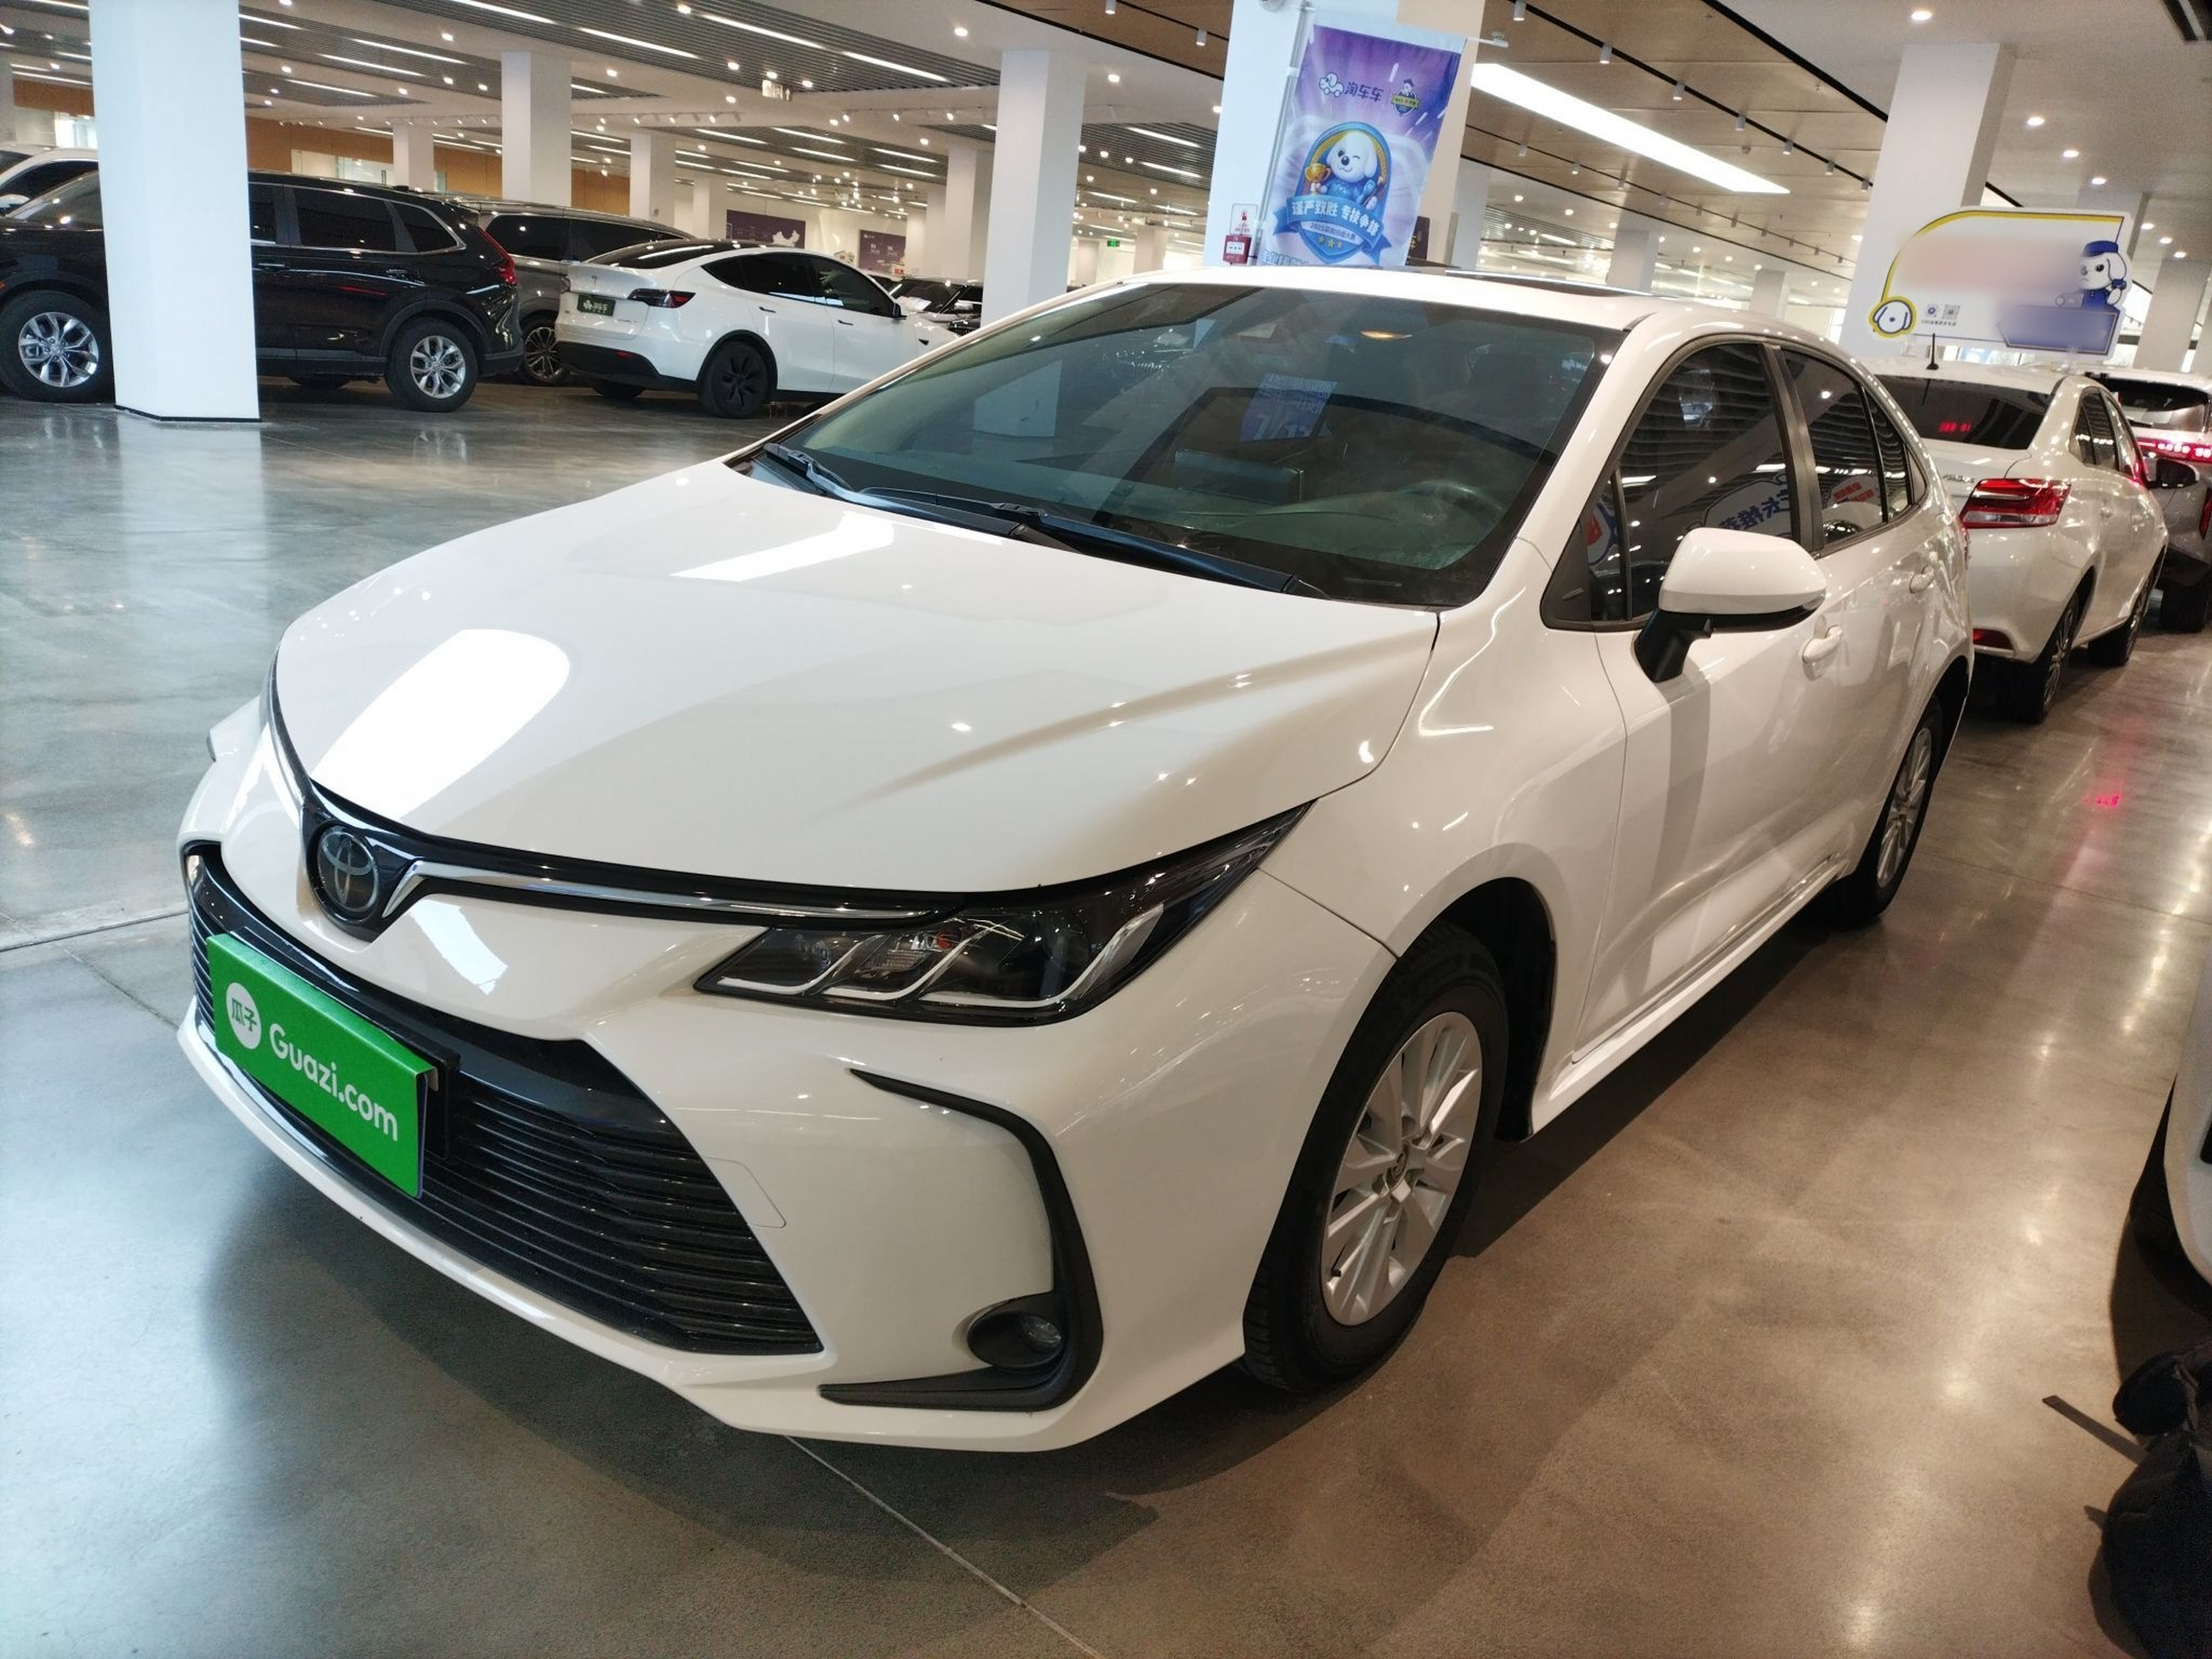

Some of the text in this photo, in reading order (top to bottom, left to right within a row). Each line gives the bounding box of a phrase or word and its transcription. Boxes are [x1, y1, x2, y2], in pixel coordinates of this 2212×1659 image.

[1344, 81, 1384, 102] 淘车车
[232, 997, 257, 1032] 瓜子
[270, 1023, 397, 1142] Guazi.com
